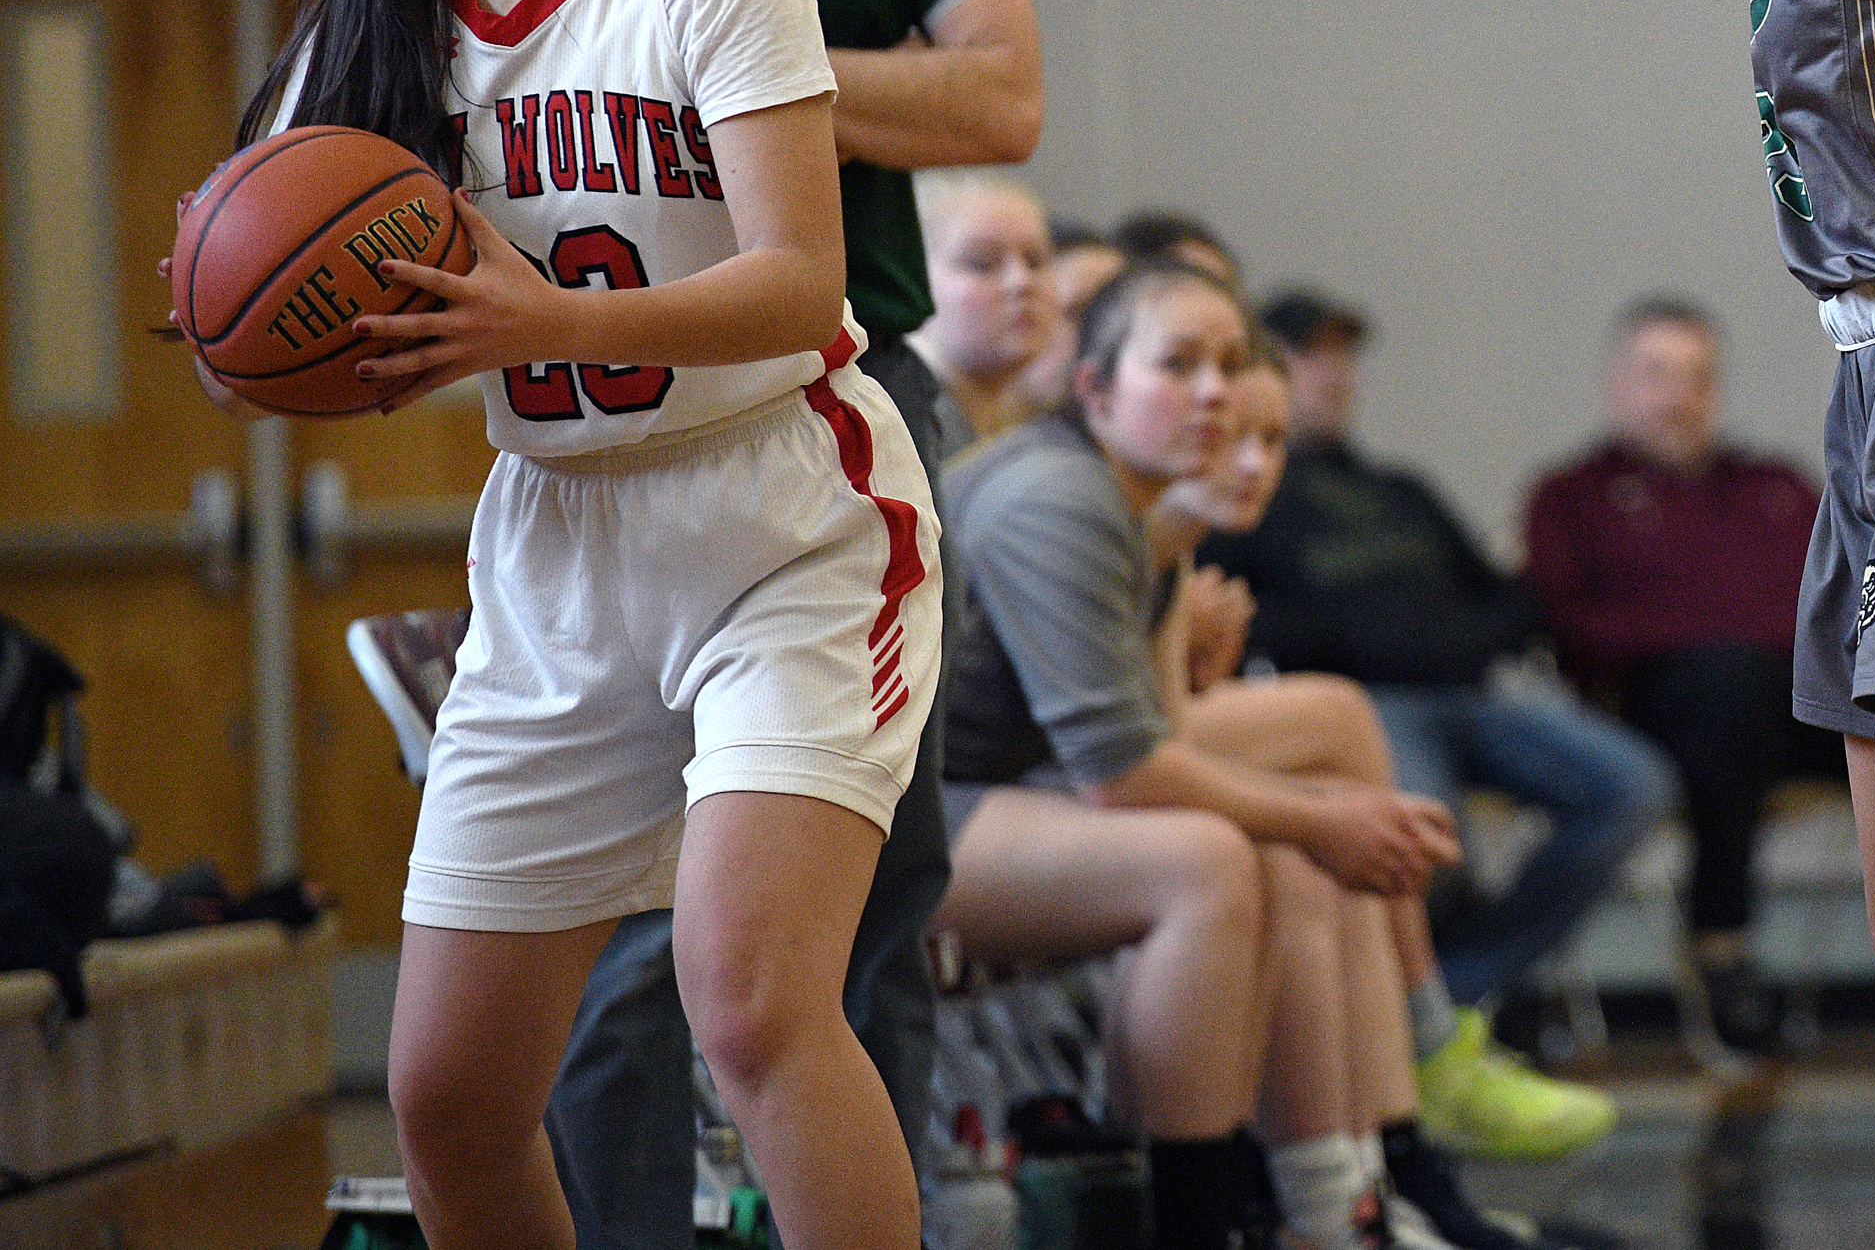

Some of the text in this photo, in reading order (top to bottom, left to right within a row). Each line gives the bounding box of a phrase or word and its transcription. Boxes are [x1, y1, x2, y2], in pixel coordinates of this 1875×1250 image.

[495, 89, 725, 201] WOLVES
[267, 197, 442, 351] THE ROCK
